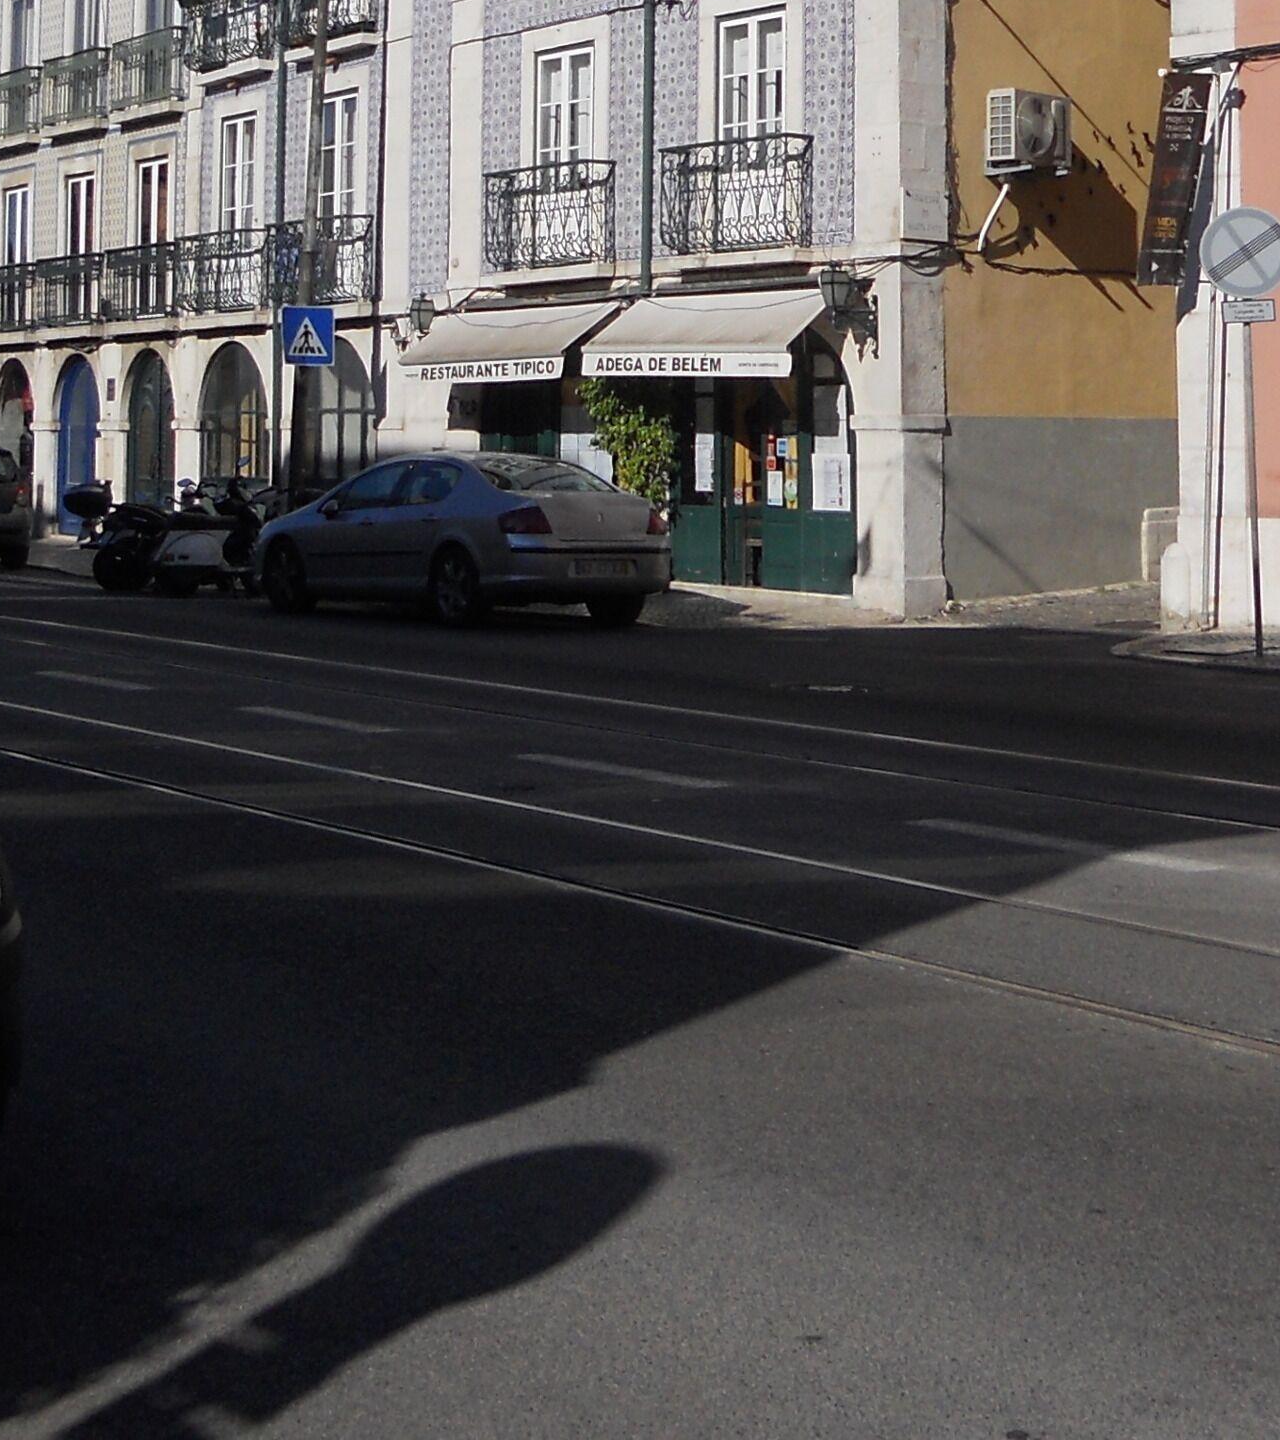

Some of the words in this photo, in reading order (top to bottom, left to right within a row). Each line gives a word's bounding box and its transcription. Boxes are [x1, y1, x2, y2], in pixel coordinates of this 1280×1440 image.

[420, 362, 510, 381] RESTAURANTE
[595, 357, 644, 372] ADEGA
[647, 357, 668, 372] DE
[671, 353, 722, 373] BELÉM
